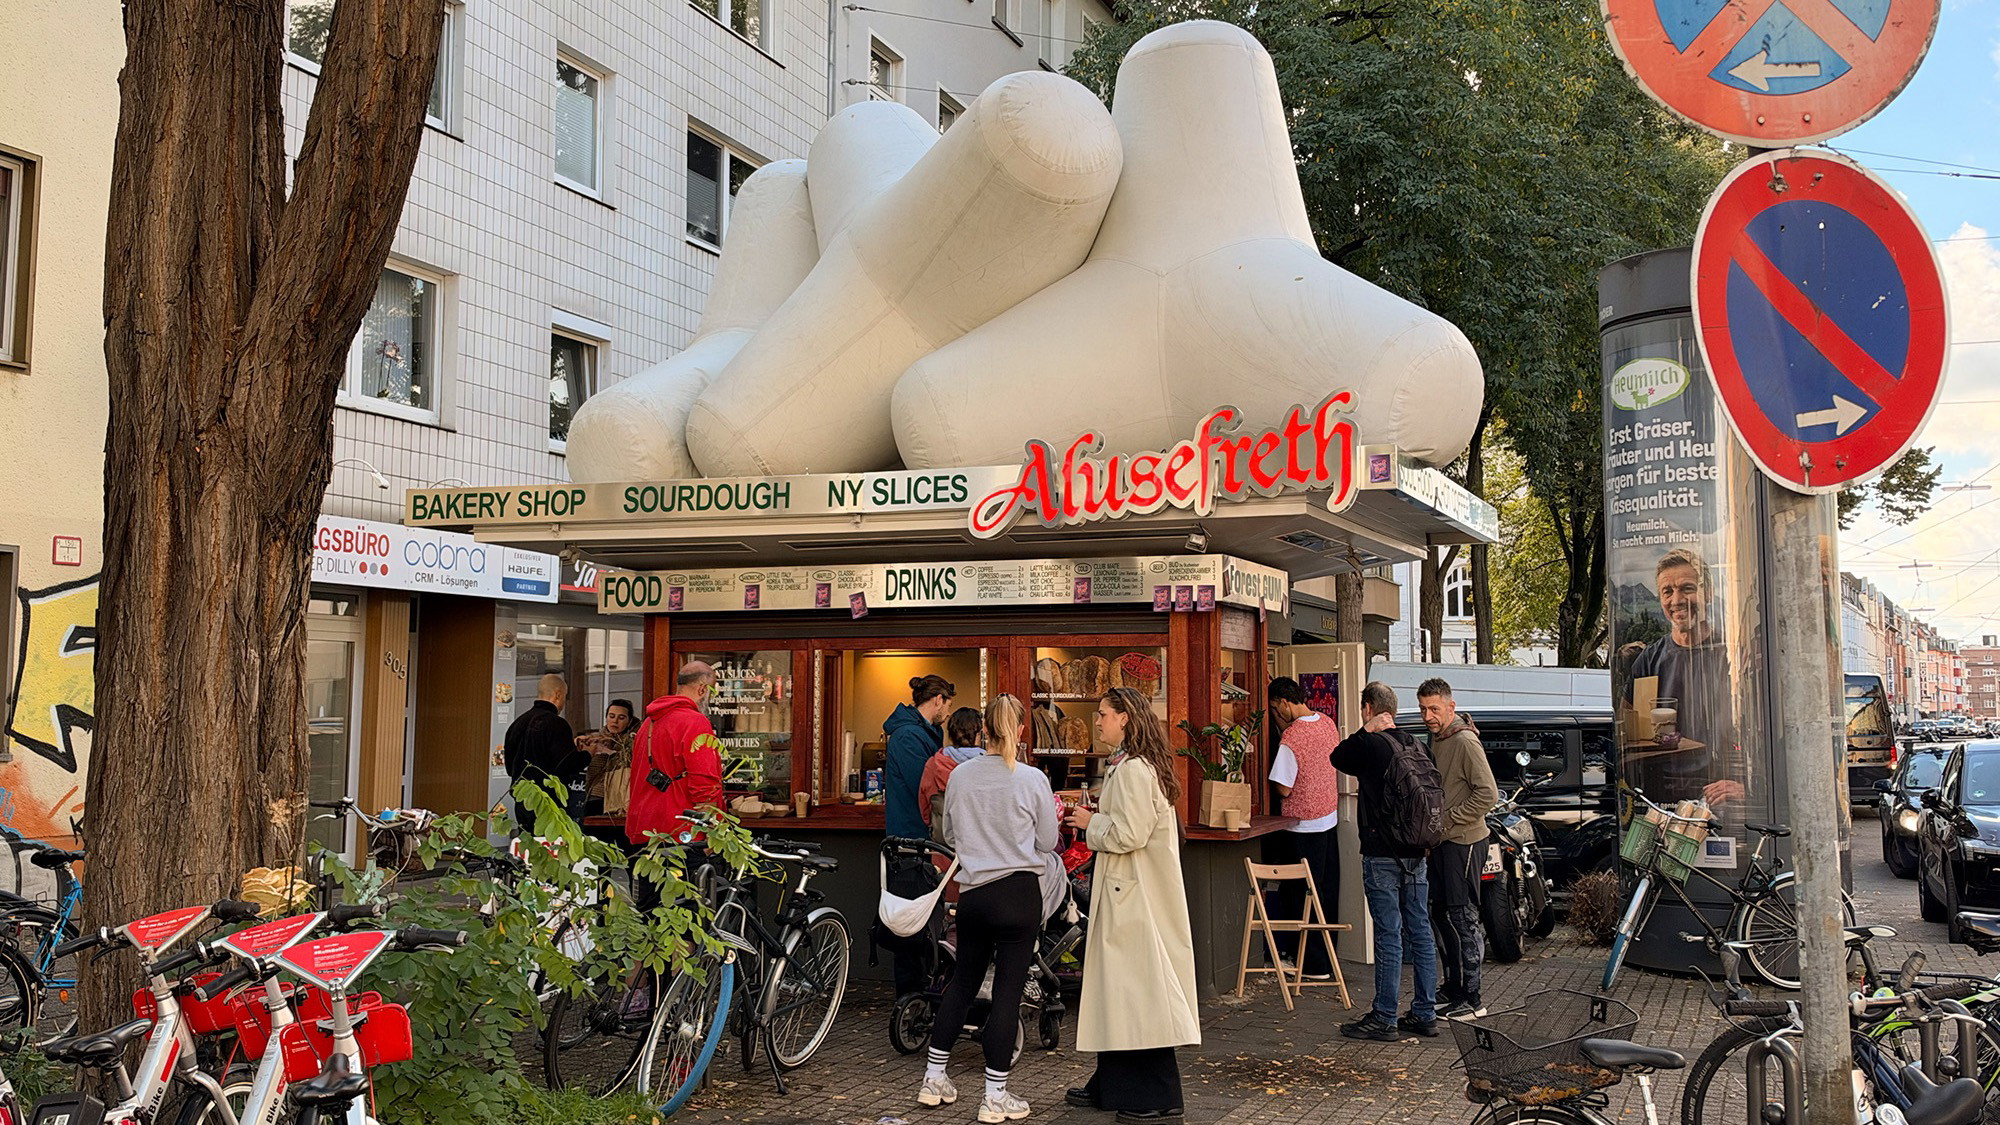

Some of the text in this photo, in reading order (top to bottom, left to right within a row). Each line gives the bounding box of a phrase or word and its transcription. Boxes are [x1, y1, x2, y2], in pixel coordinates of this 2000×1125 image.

[1614, 368, 1679, 393] Heumilch
[1609, 418, 1695, 446] Erst Gräser,
[1644, 446, 1675, 463] und
[1680, 439, 1716, 459] Heu
[1636, 465, 1661, 486] für
[1664, 462, 1720, 484] beste
[412, 474, 969, 520] BAKERY SHOP SOURDOUGH NY SLICES
[1610, 487, 1704, 517] Käsequalität.
[1620, 534, 1644, 548] macht
[1645, 534, 1666, 546] man
[1669, 530, 1700, 544] Milch.
[1626, 517, 1669, 533] Heumilch.
[314, 525, 390, 558] GSBÜRO
[404, 536, 486, 574] cobra
[327, 557, 357, 575] DILLY
[415, 572, 434, 583] CRM
[441, 575, 479, 589] Lösungen
[604, 576, 662, 608] FOOD
[885, 567, 957, 601] DRINKS
[1230, 564, 1262, 598] Forest
[1263, 574, 1282, 602] GUM
[385, 651, 407, 680] 305
[266, 1097, 280, 1124] Bike
